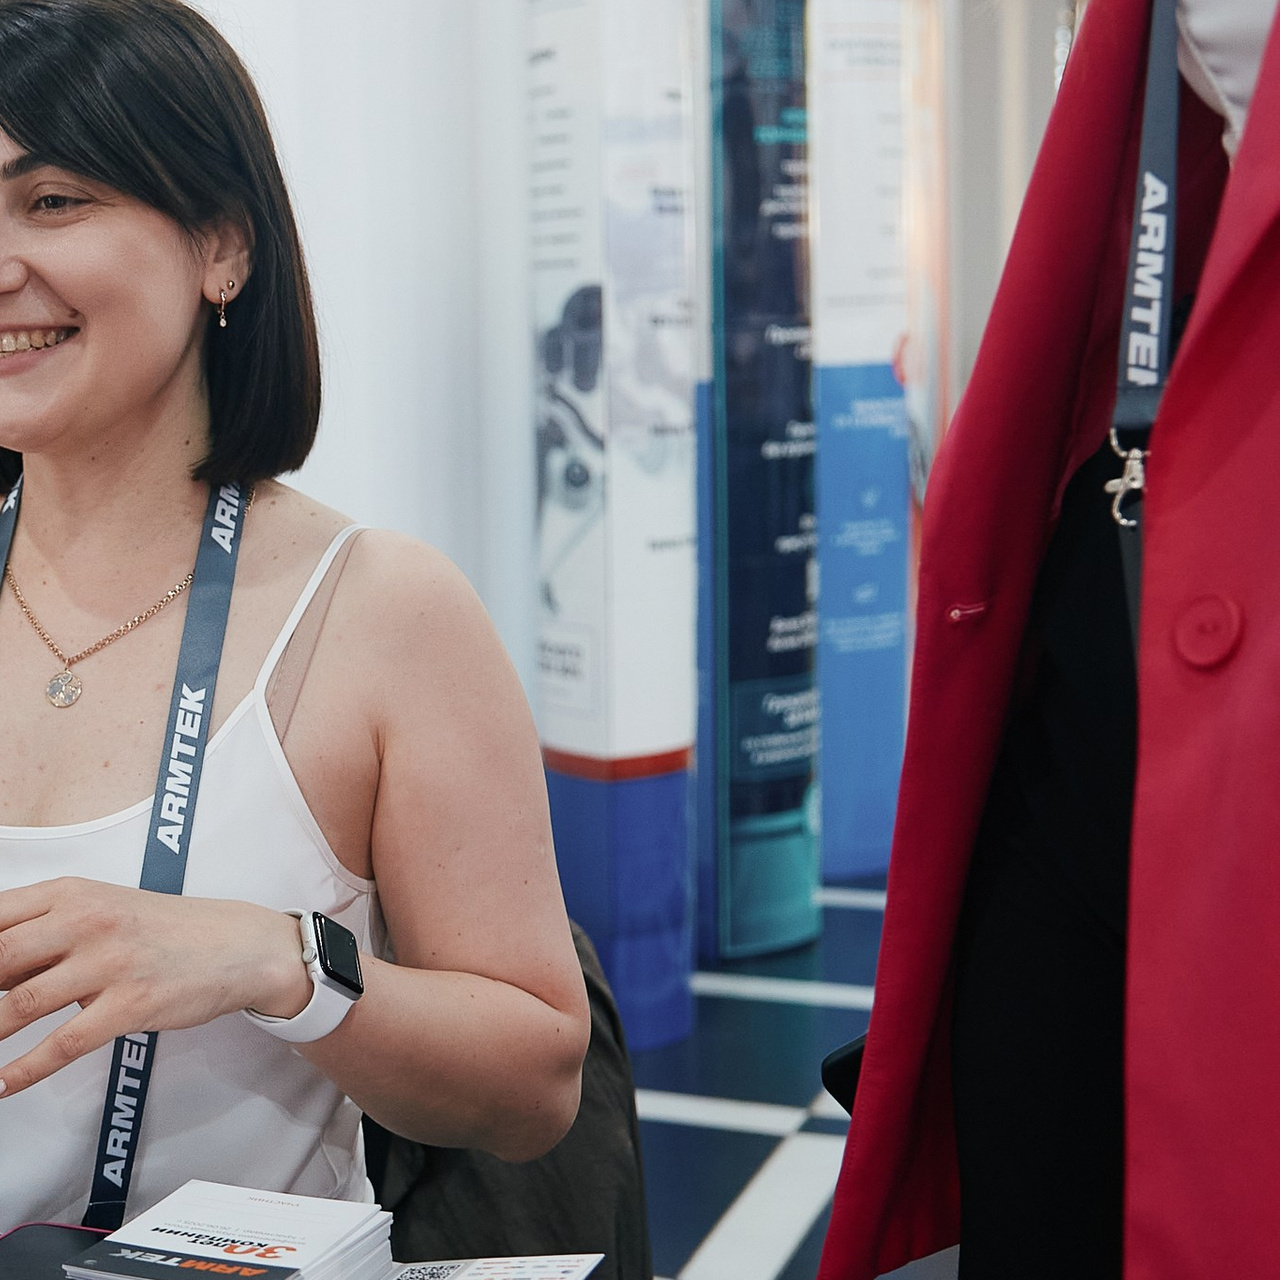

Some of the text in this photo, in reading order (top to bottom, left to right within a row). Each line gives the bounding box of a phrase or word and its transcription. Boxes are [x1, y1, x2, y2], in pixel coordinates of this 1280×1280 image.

[157, 683, 207, 855] ARMTEK
[150, 1227, 268, 1248] компании
[185, 1238, 297, 1260] 30 лет
[108, 1247, 267, 1277] ARMTEK
